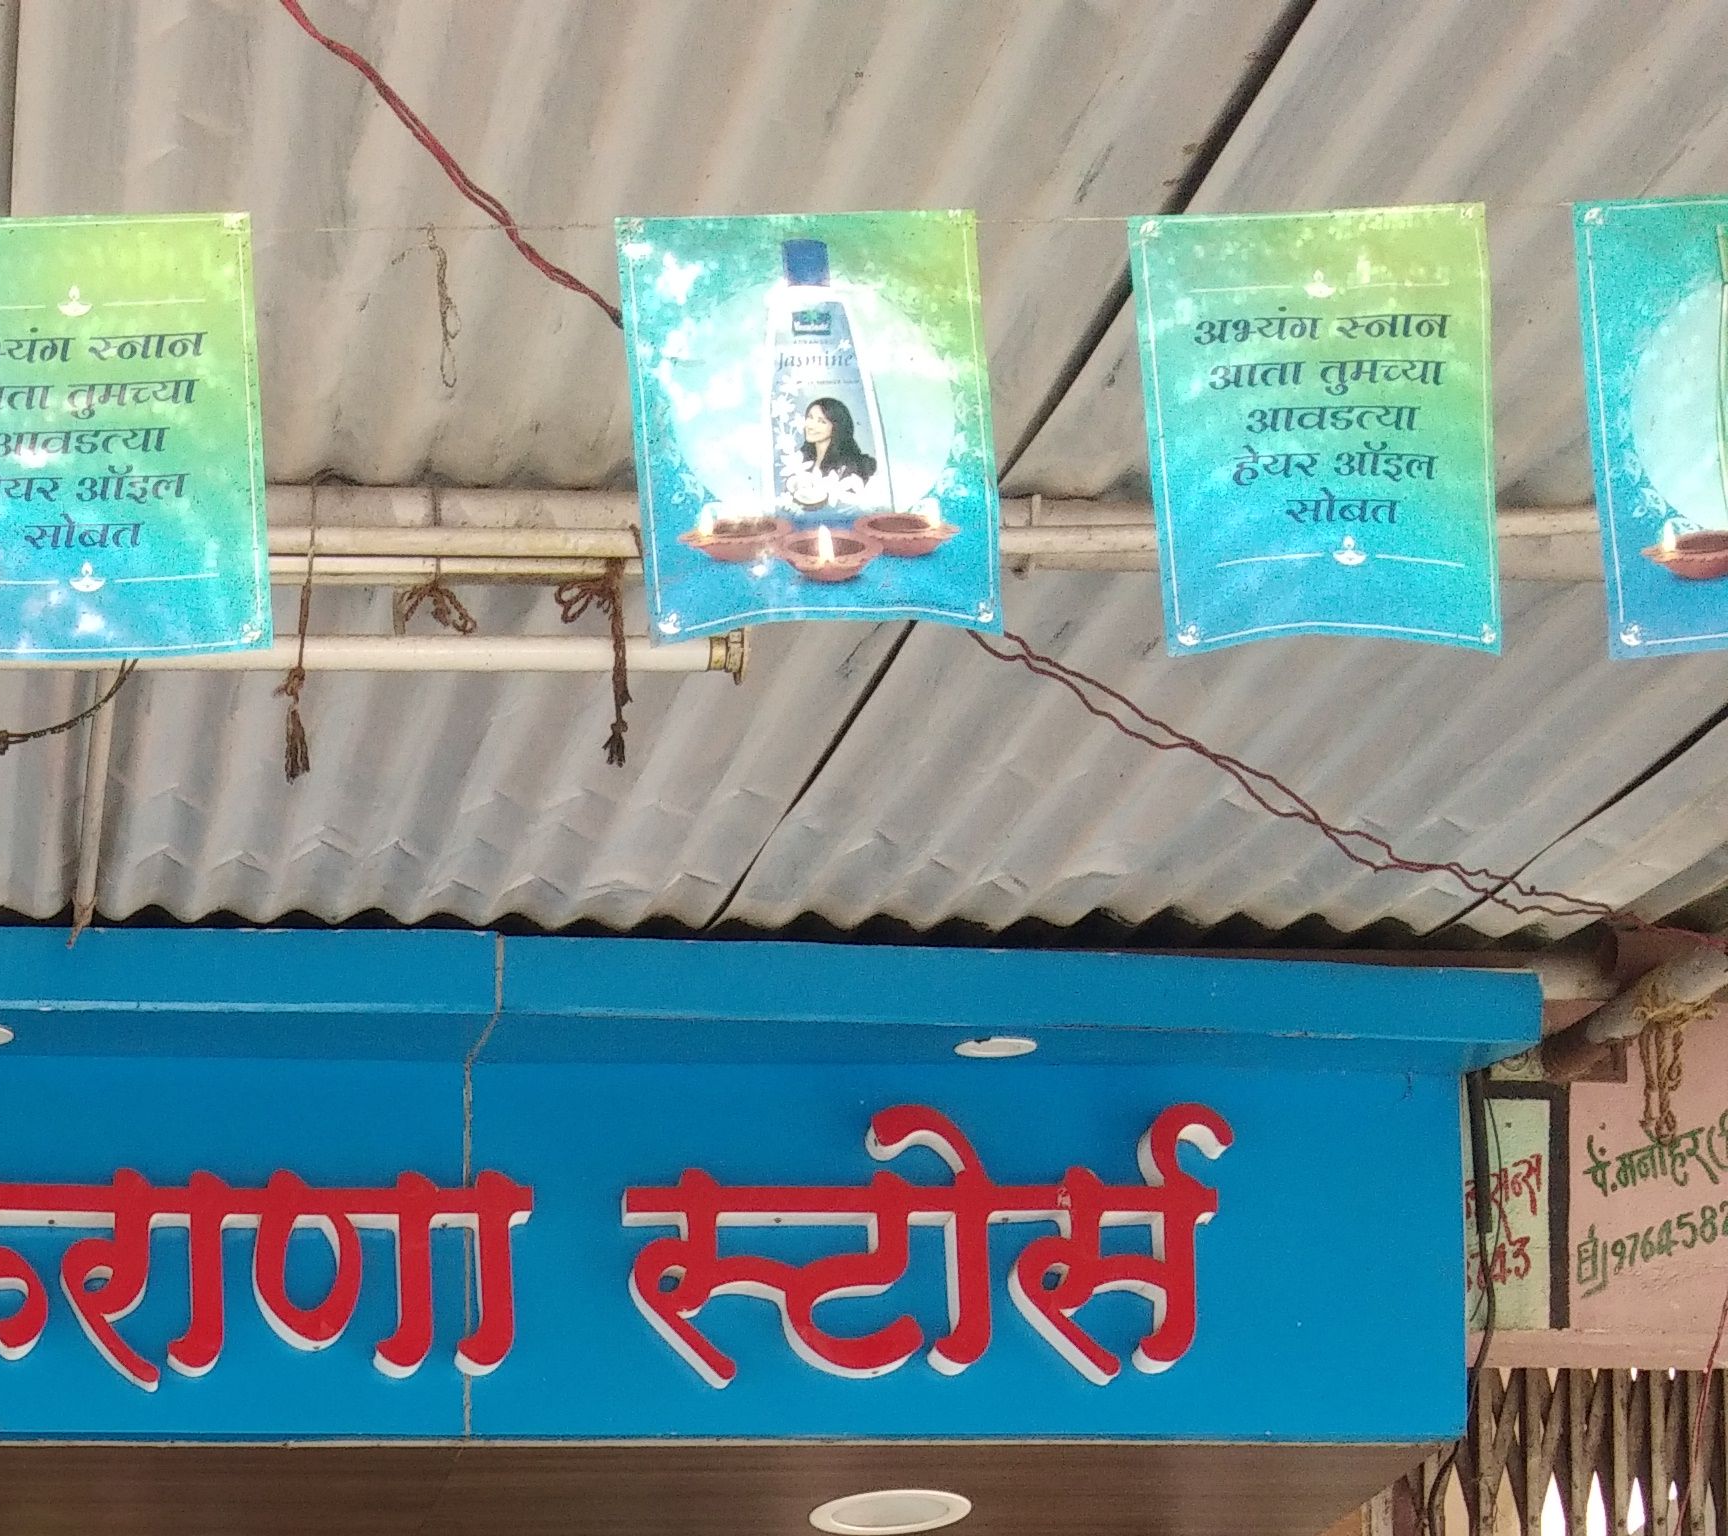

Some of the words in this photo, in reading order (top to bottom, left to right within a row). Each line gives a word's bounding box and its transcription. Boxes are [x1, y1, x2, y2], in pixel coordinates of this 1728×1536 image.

[1194, 306, 1323, 345] अभ्यंग
[1335, 314, 1451, 340] स्नान
[88, 331, 208, 361] स्नान
[1208, 360, 1306, 391] आता
[1319, 359, 1446, 396] तुमच्या
[67, 379, 200, 420] तुमच्या
[1246, 405, 1421, 433] आवडत्या
[1232, 445, 1321, 486] हेयर
[1333, 441, 1439, 483] ऑइल
[76, 465, 190, 504] ऑइल
[1285, 487, 1401, 524] सोबत
[23, 513, 144, 549] सोबत
[621, 1102, 1234, 1388] स्टोर्स
